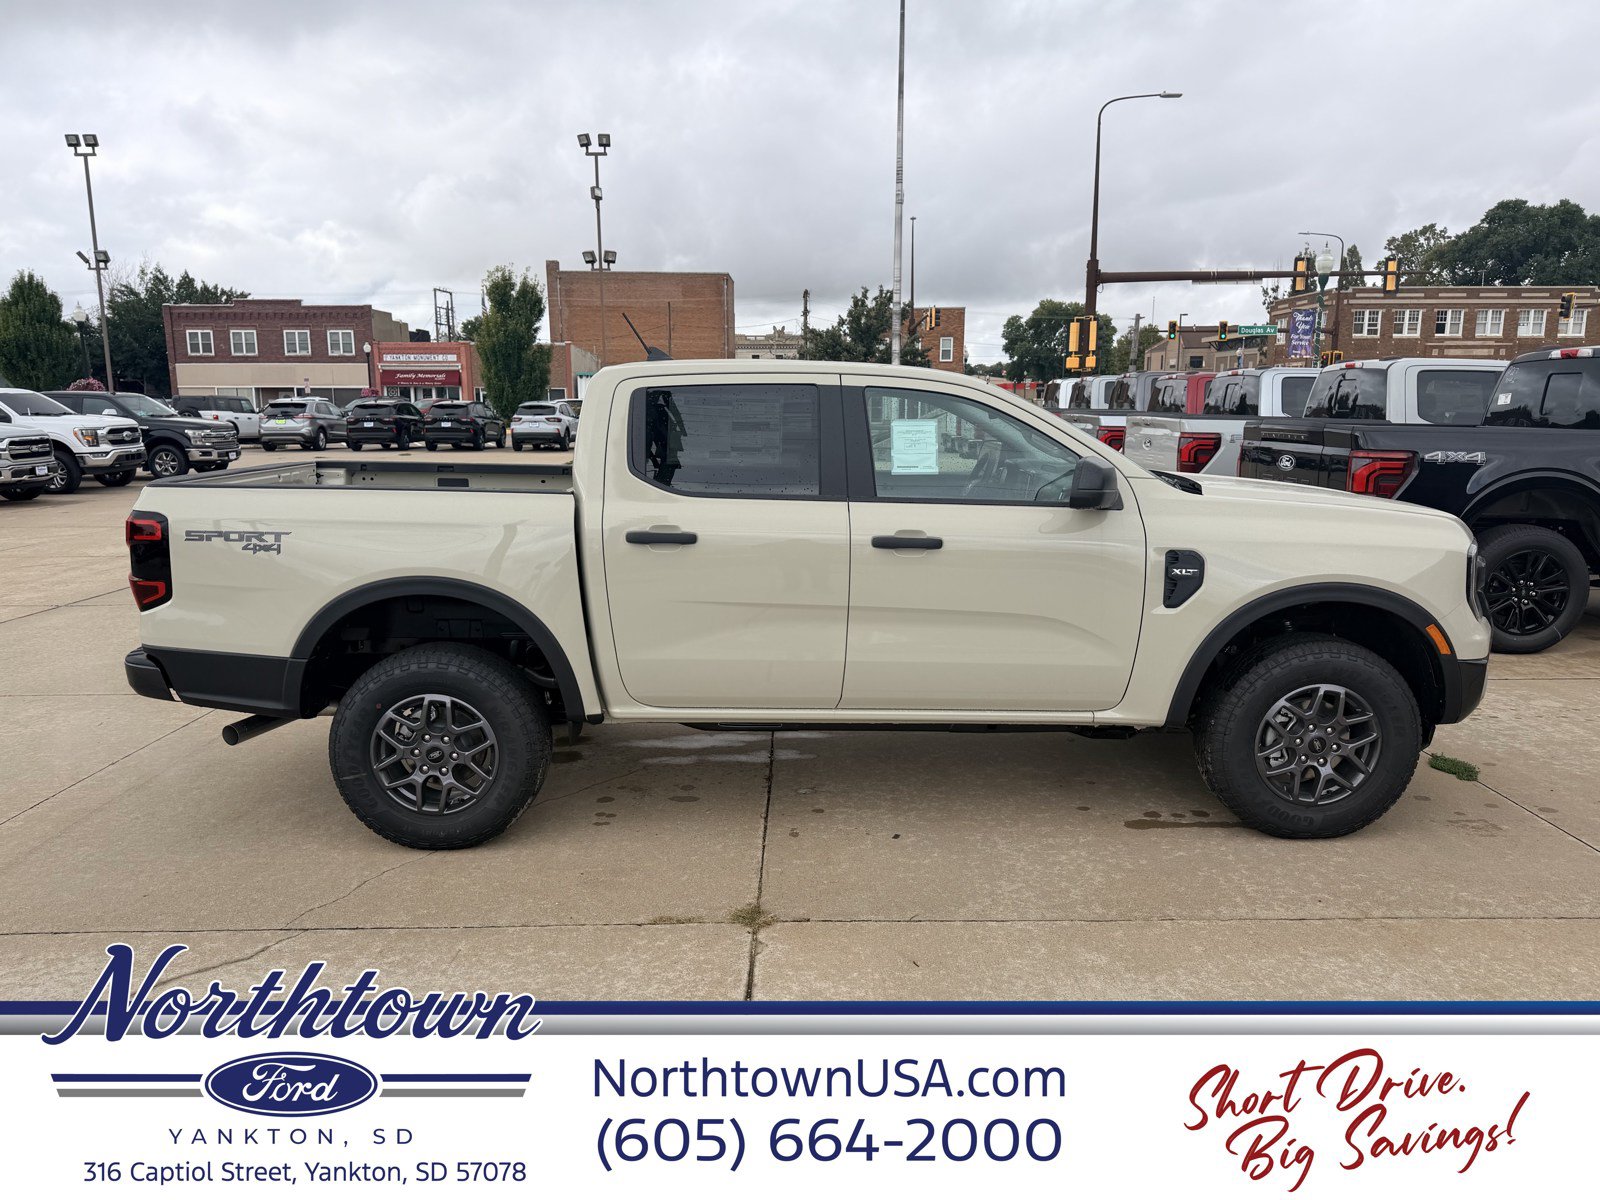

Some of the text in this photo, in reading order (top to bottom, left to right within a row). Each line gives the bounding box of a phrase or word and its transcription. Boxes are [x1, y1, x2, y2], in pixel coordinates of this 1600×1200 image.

[1241, 326, 1264, 334] Douglas
[1295, 321, 1310, 334] You
[184, 530, 292, 543] SPORT
[1171, 568, 1199, 576] XLT
